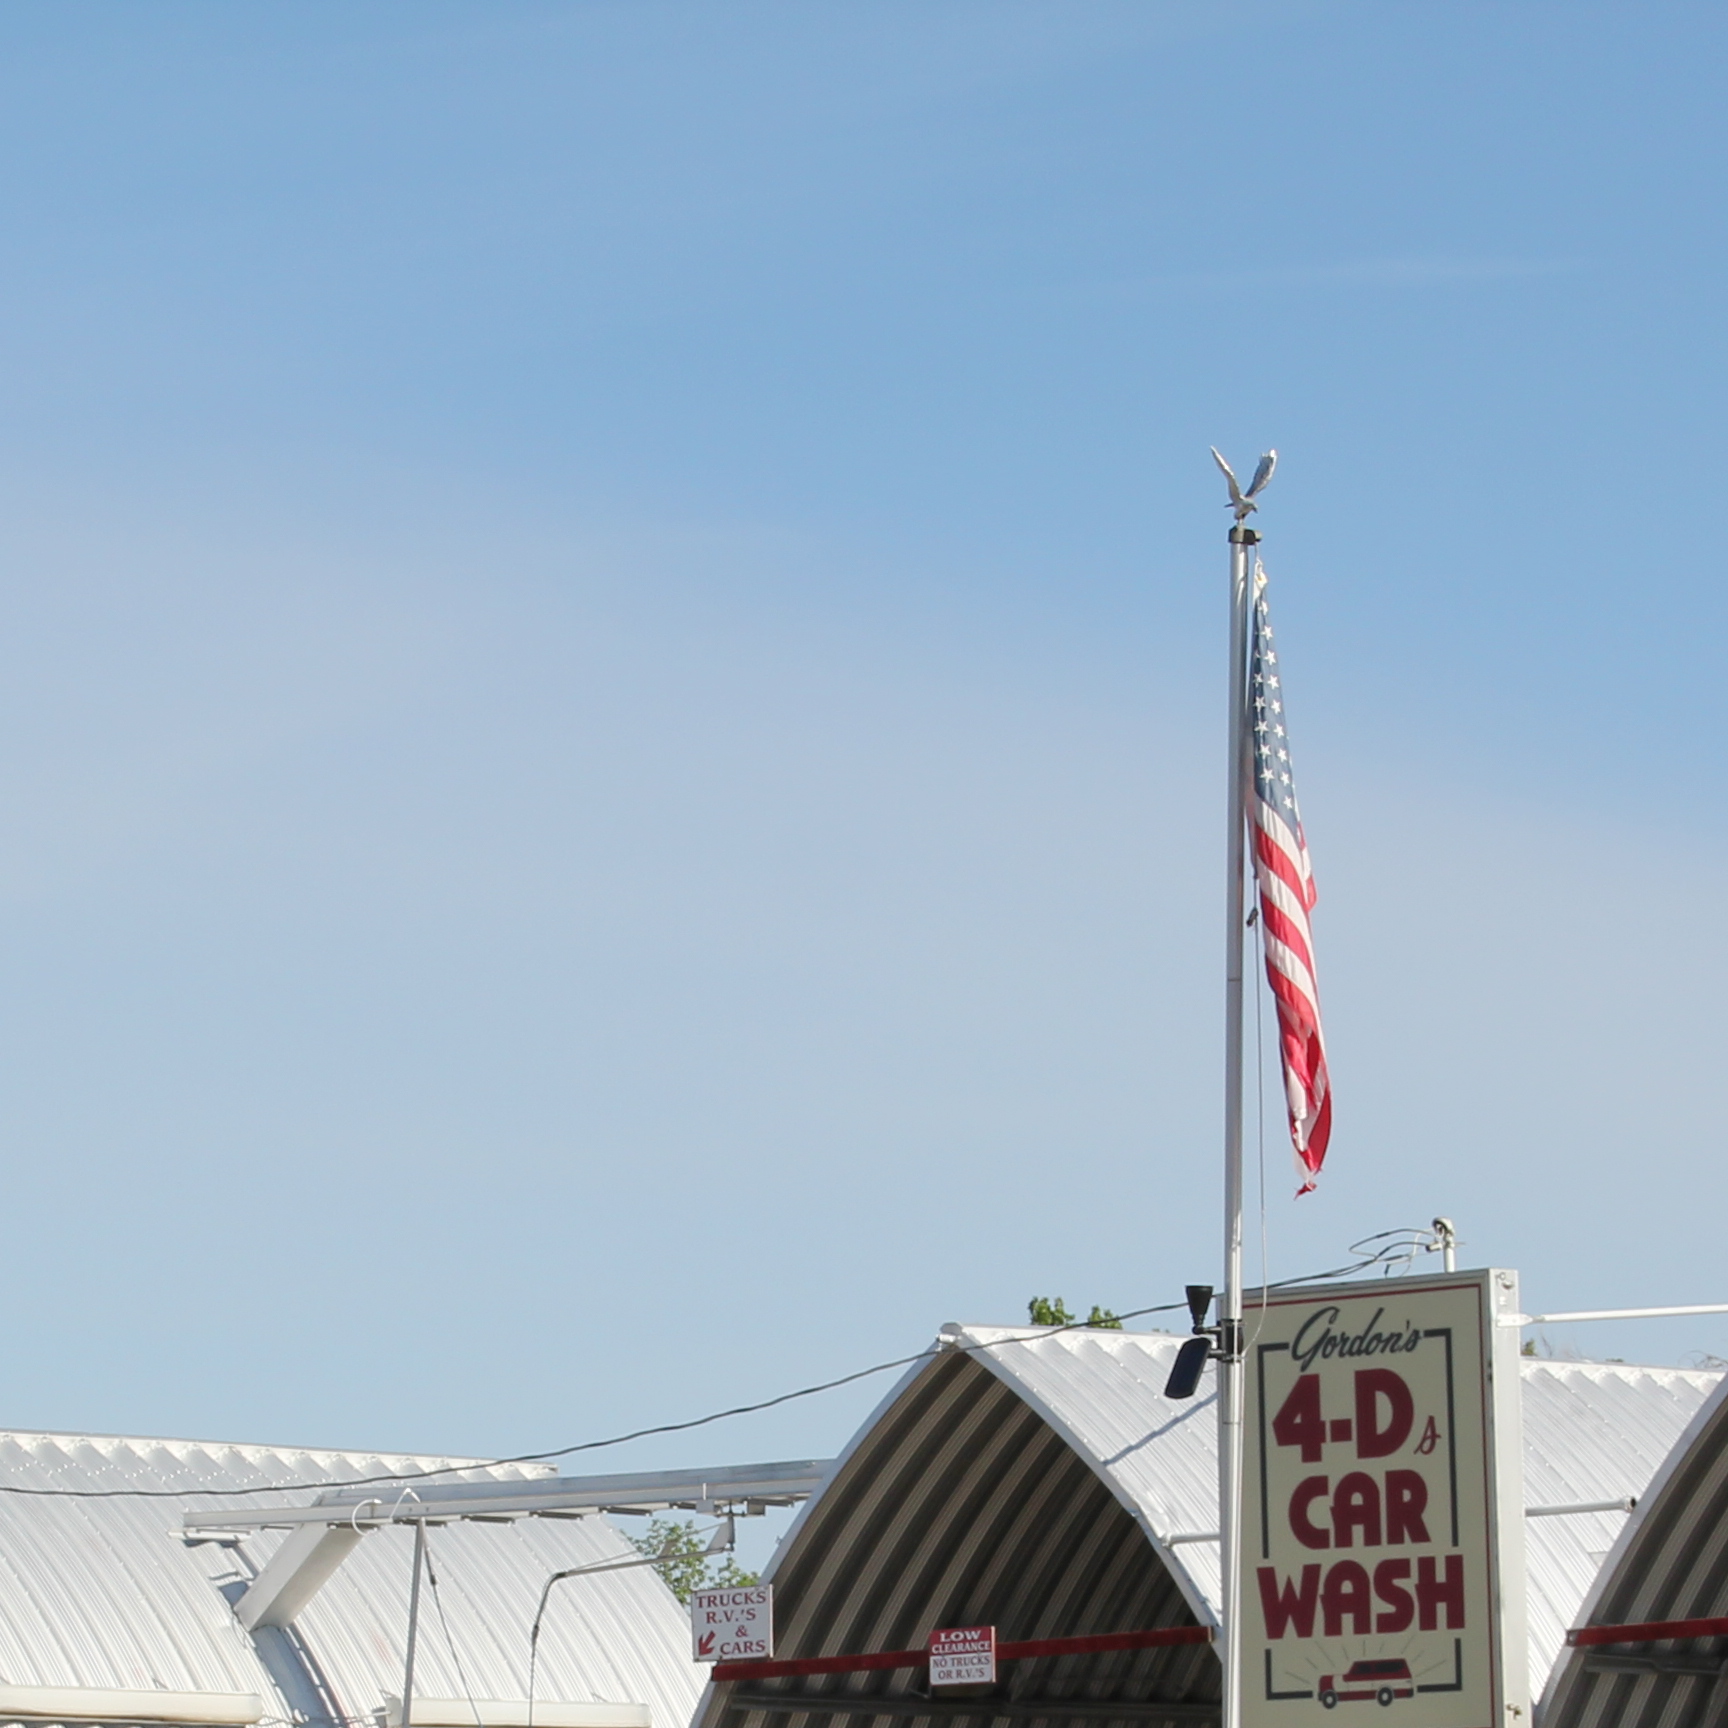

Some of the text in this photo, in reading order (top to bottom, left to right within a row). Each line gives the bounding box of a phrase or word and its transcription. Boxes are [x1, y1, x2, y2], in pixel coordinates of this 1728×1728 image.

[1291, 1306, 1422, 1373] Gordon's
[1288, 1469, 1432, 1550] CAR
[696, 1591, 767, 1608] TRUCKS
[1256, 1554, 1466, 1640] WASH
[706, 1608, 756, 1624] R.V.'S
[735, 1625, 748, 1638] &
[940, 1630, 981, 1642] LOW
[720, 1640, 766, 1655] CARS
[932, 1641, 991, 1654] CLEARANCE
[933, 1655, 990, 1668] NO TRUCKS
[938, 1670, 952, 1680] OR
